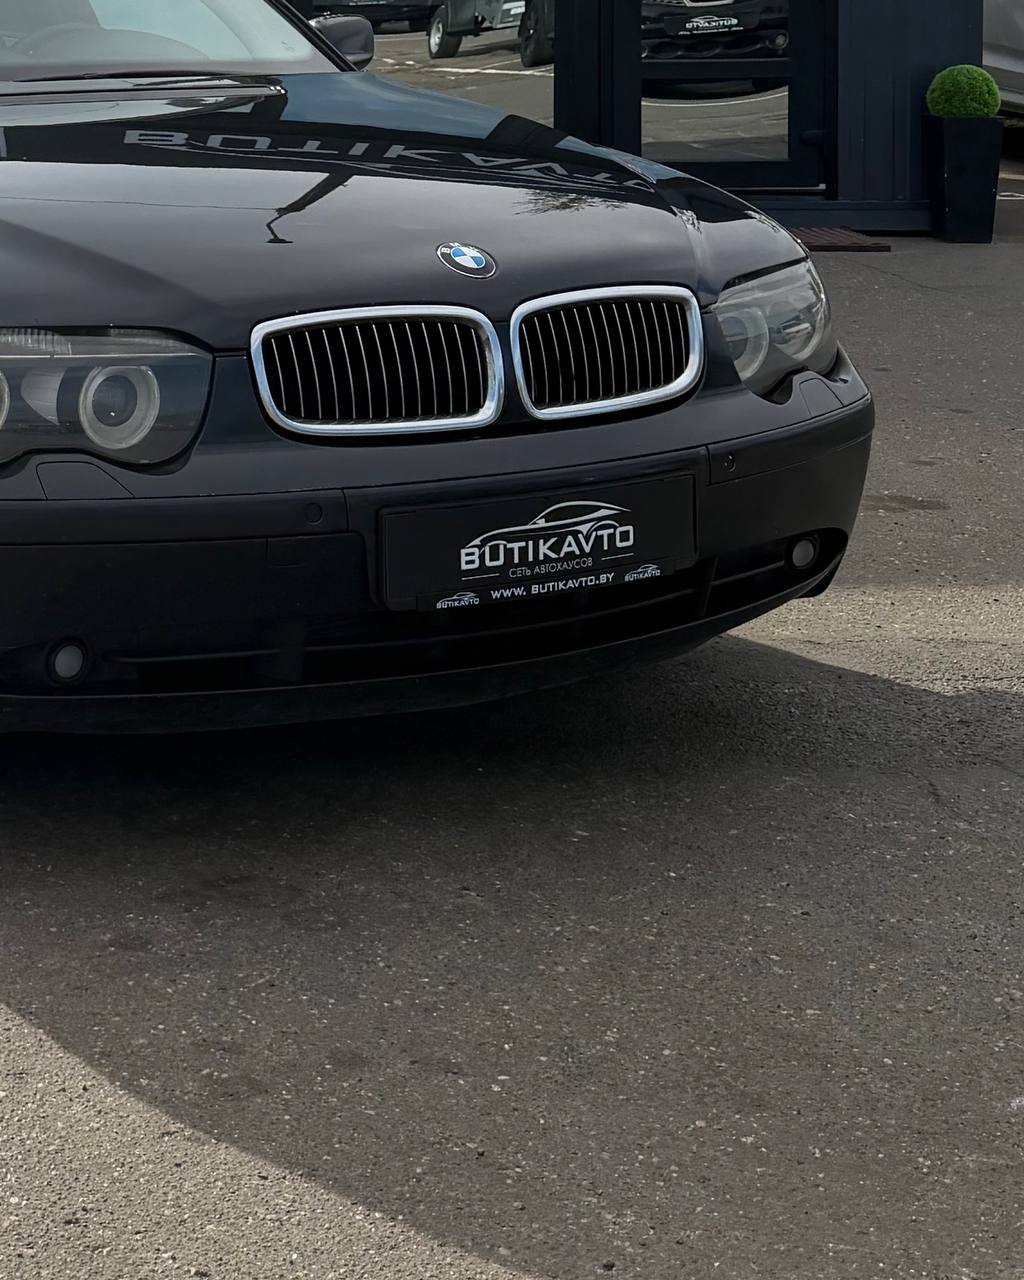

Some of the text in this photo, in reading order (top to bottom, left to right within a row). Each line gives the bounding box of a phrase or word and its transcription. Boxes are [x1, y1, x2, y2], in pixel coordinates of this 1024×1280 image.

[460, 524, 634, 570] BUTIKAVTO
[509, 557, 593, 578] СЕТЬ АВТОХАУСОВ
[625, 569, 661, 582] BUTIKAVTO
[491, 572, 614, 599] WWW. BUTIKAVTO.BY
[436, 598, 480, 609] BUTIKAVTO
